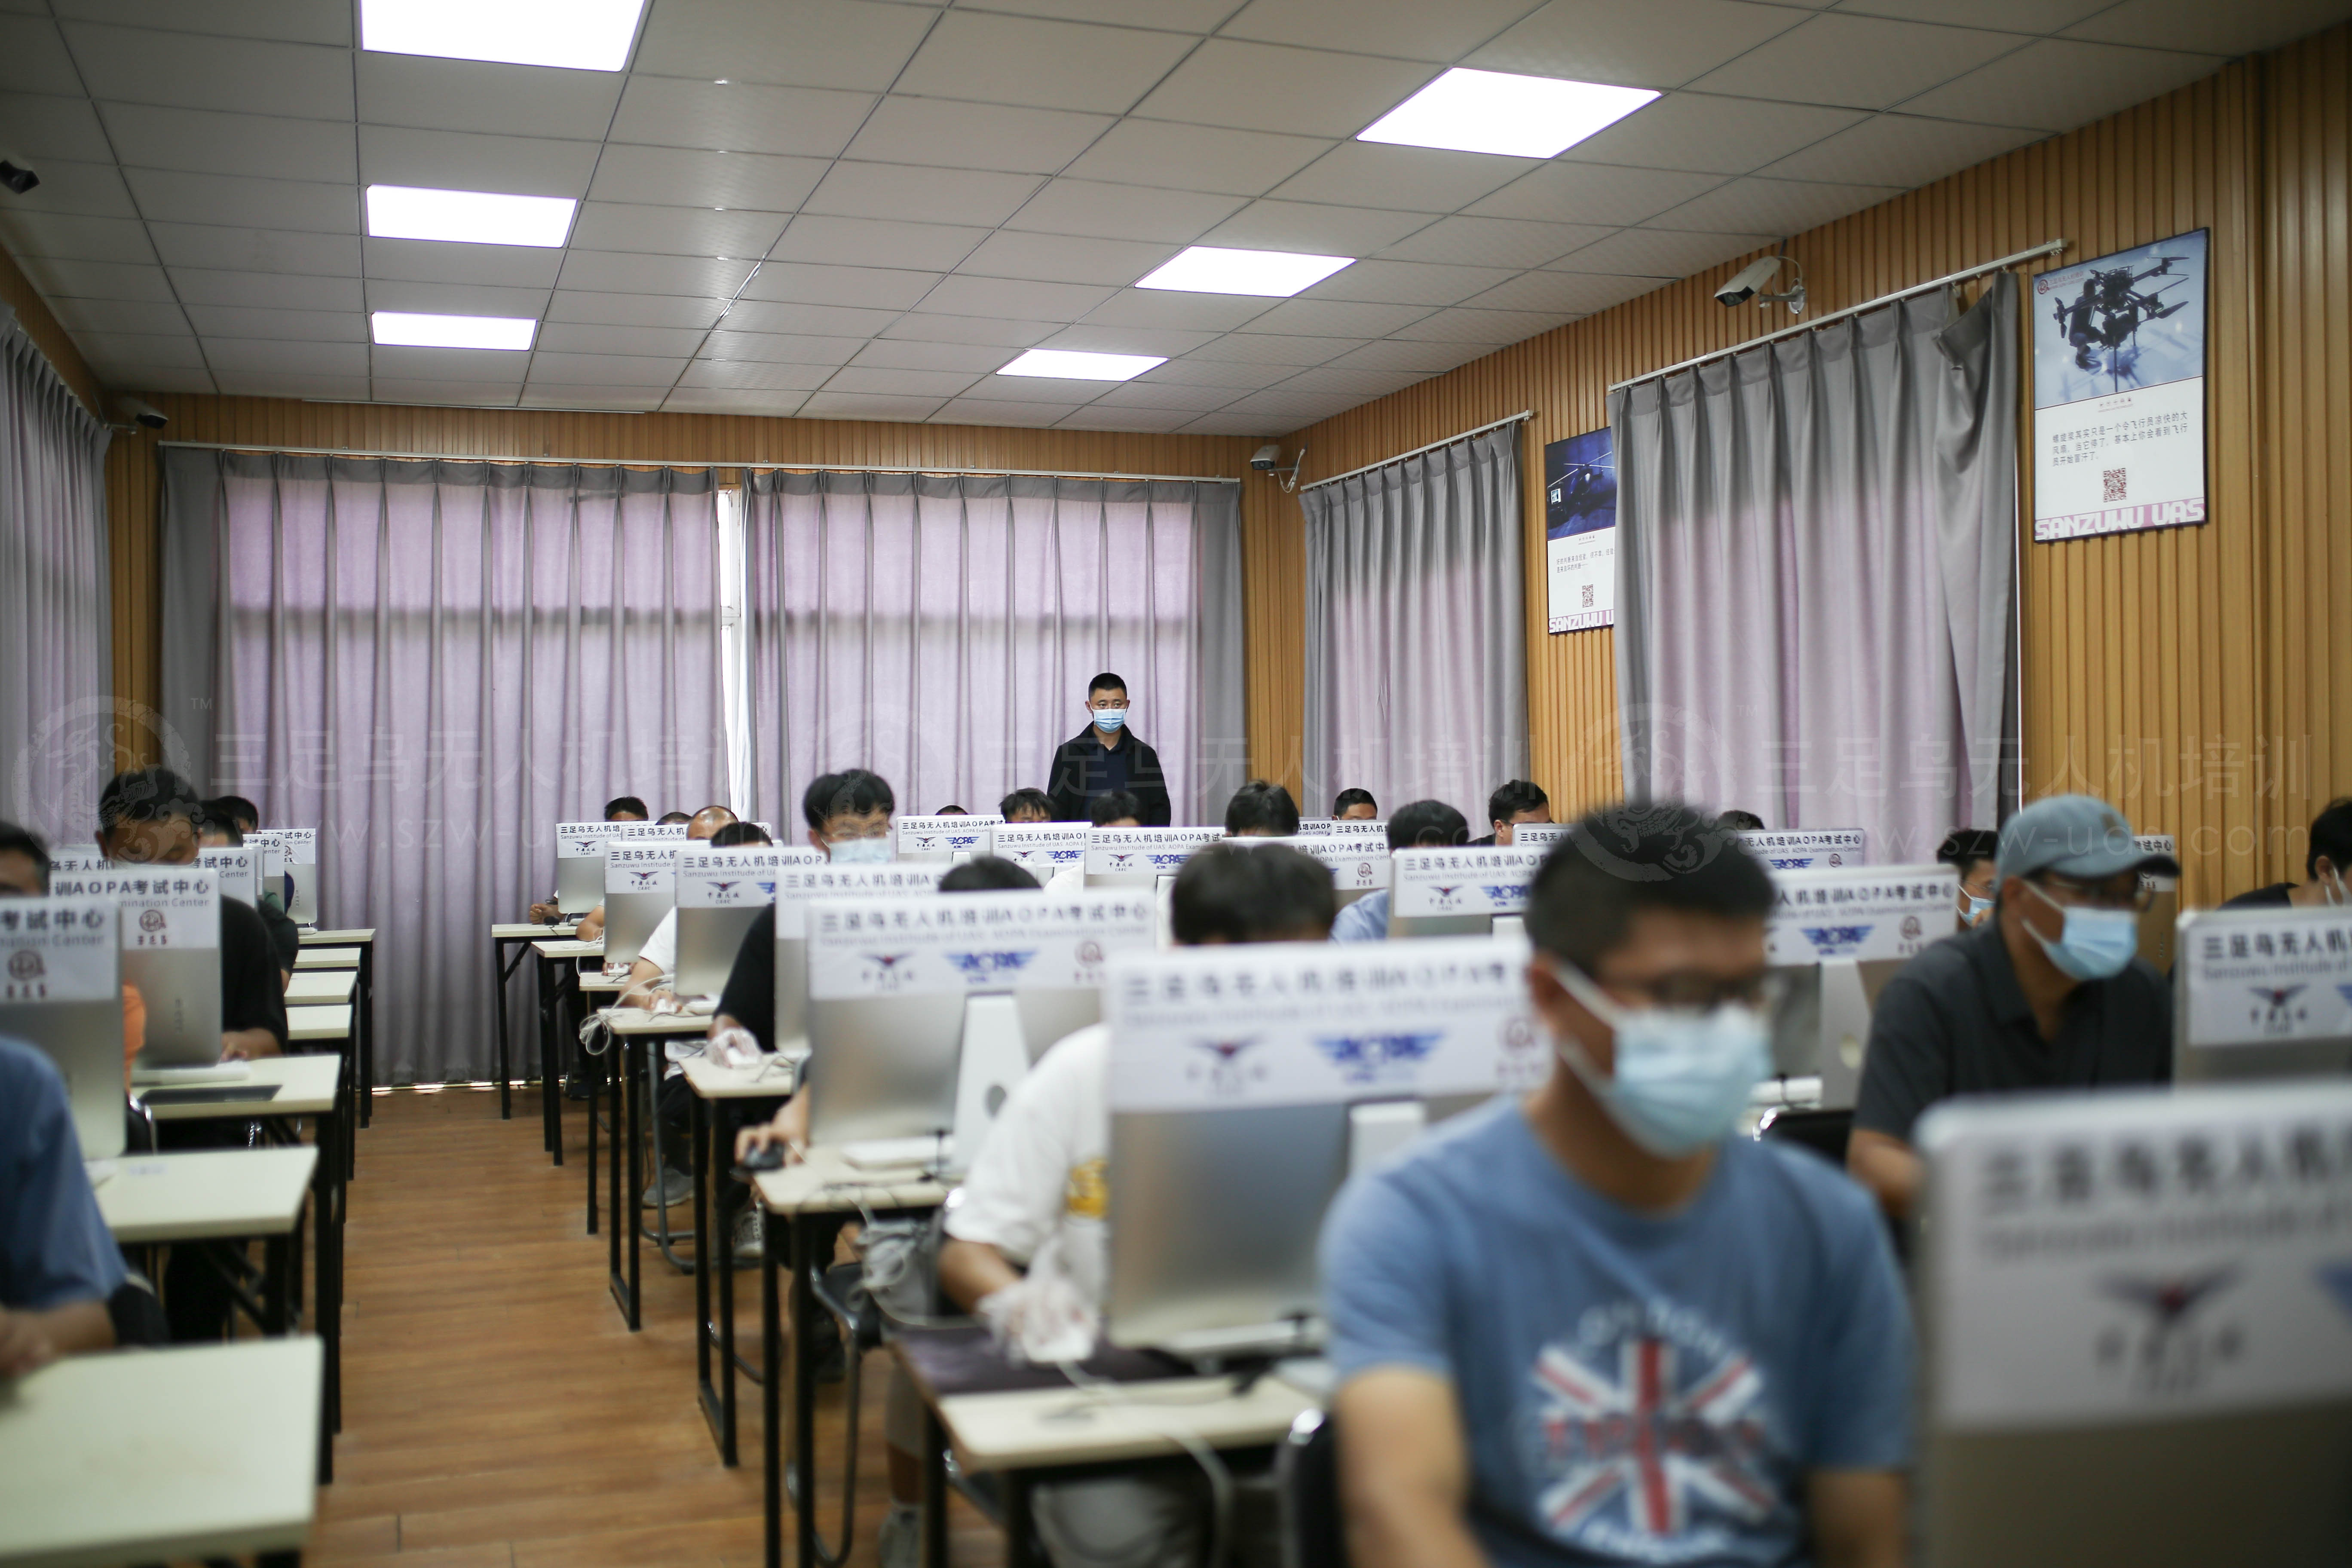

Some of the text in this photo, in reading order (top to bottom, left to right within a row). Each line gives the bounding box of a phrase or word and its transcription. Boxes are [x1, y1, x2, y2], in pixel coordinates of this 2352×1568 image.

[2035, 499, 2205, 540] SANZUWU UAS
[1548, 613, 1602, 633] SANZUWU
[627, 827, 685, 836] 三足乌无人机
[1091, 833, 1226, 843] 三足乌无人机培训AOPA考试
[172, 898, 210, 907] Center
